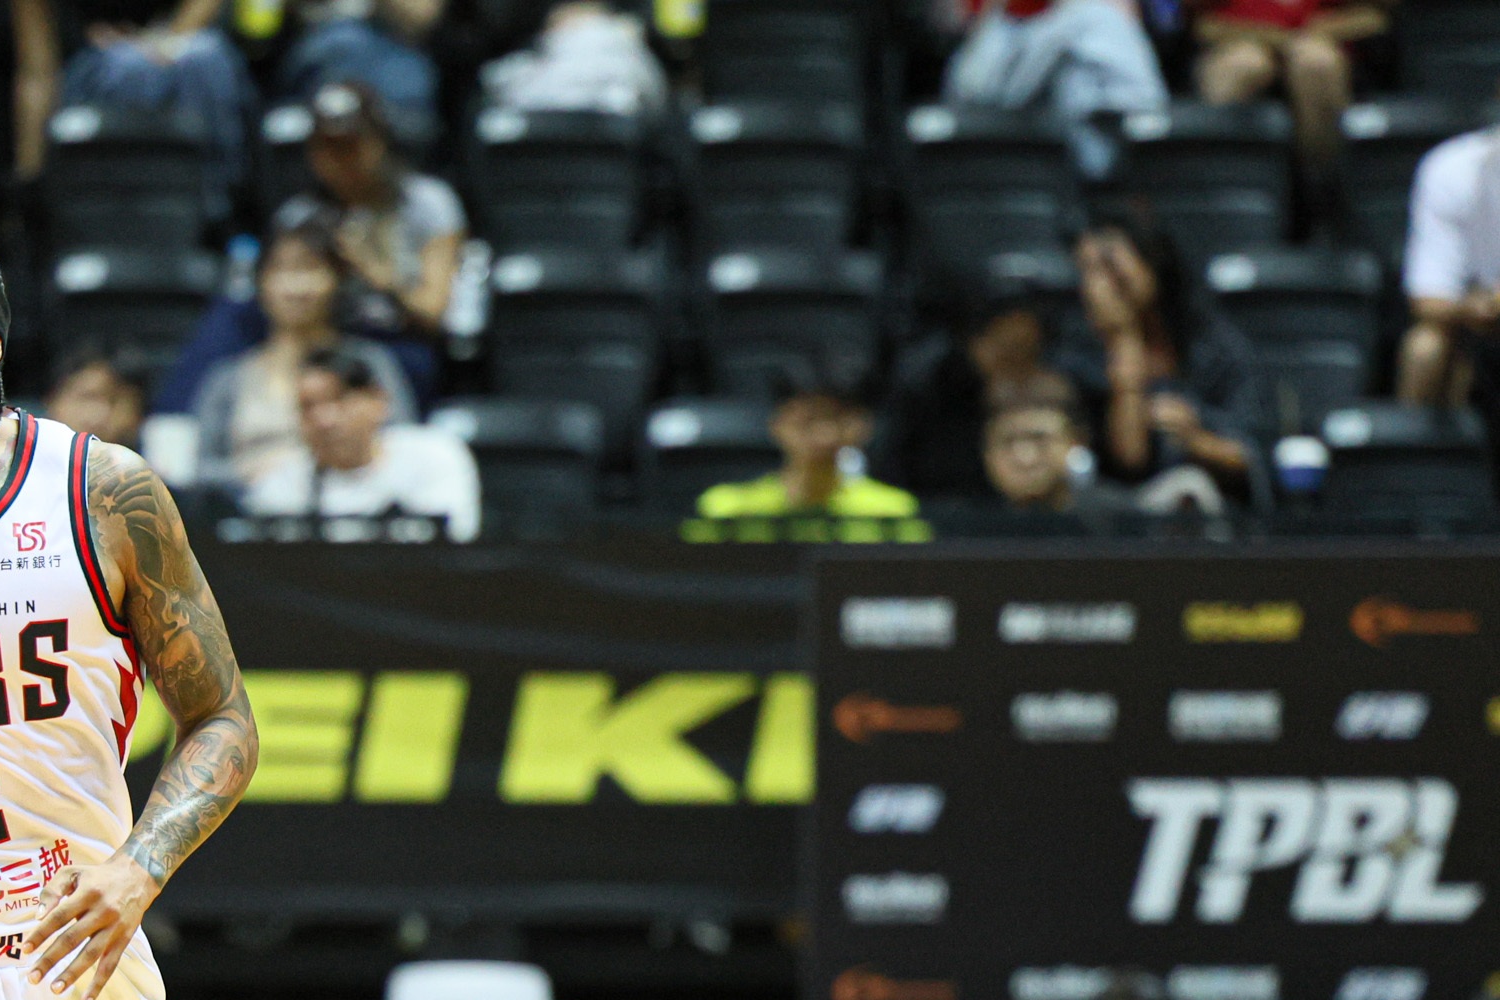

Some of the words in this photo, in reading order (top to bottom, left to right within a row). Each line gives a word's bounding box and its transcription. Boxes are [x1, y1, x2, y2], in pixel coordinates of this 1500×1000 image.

[0, 554, 62, 571] 台新銀行
[499, 670, 817, 804] KI
[1124, 776, 1485, 925] TPBL
[5, 895, 40, 912] MITS
